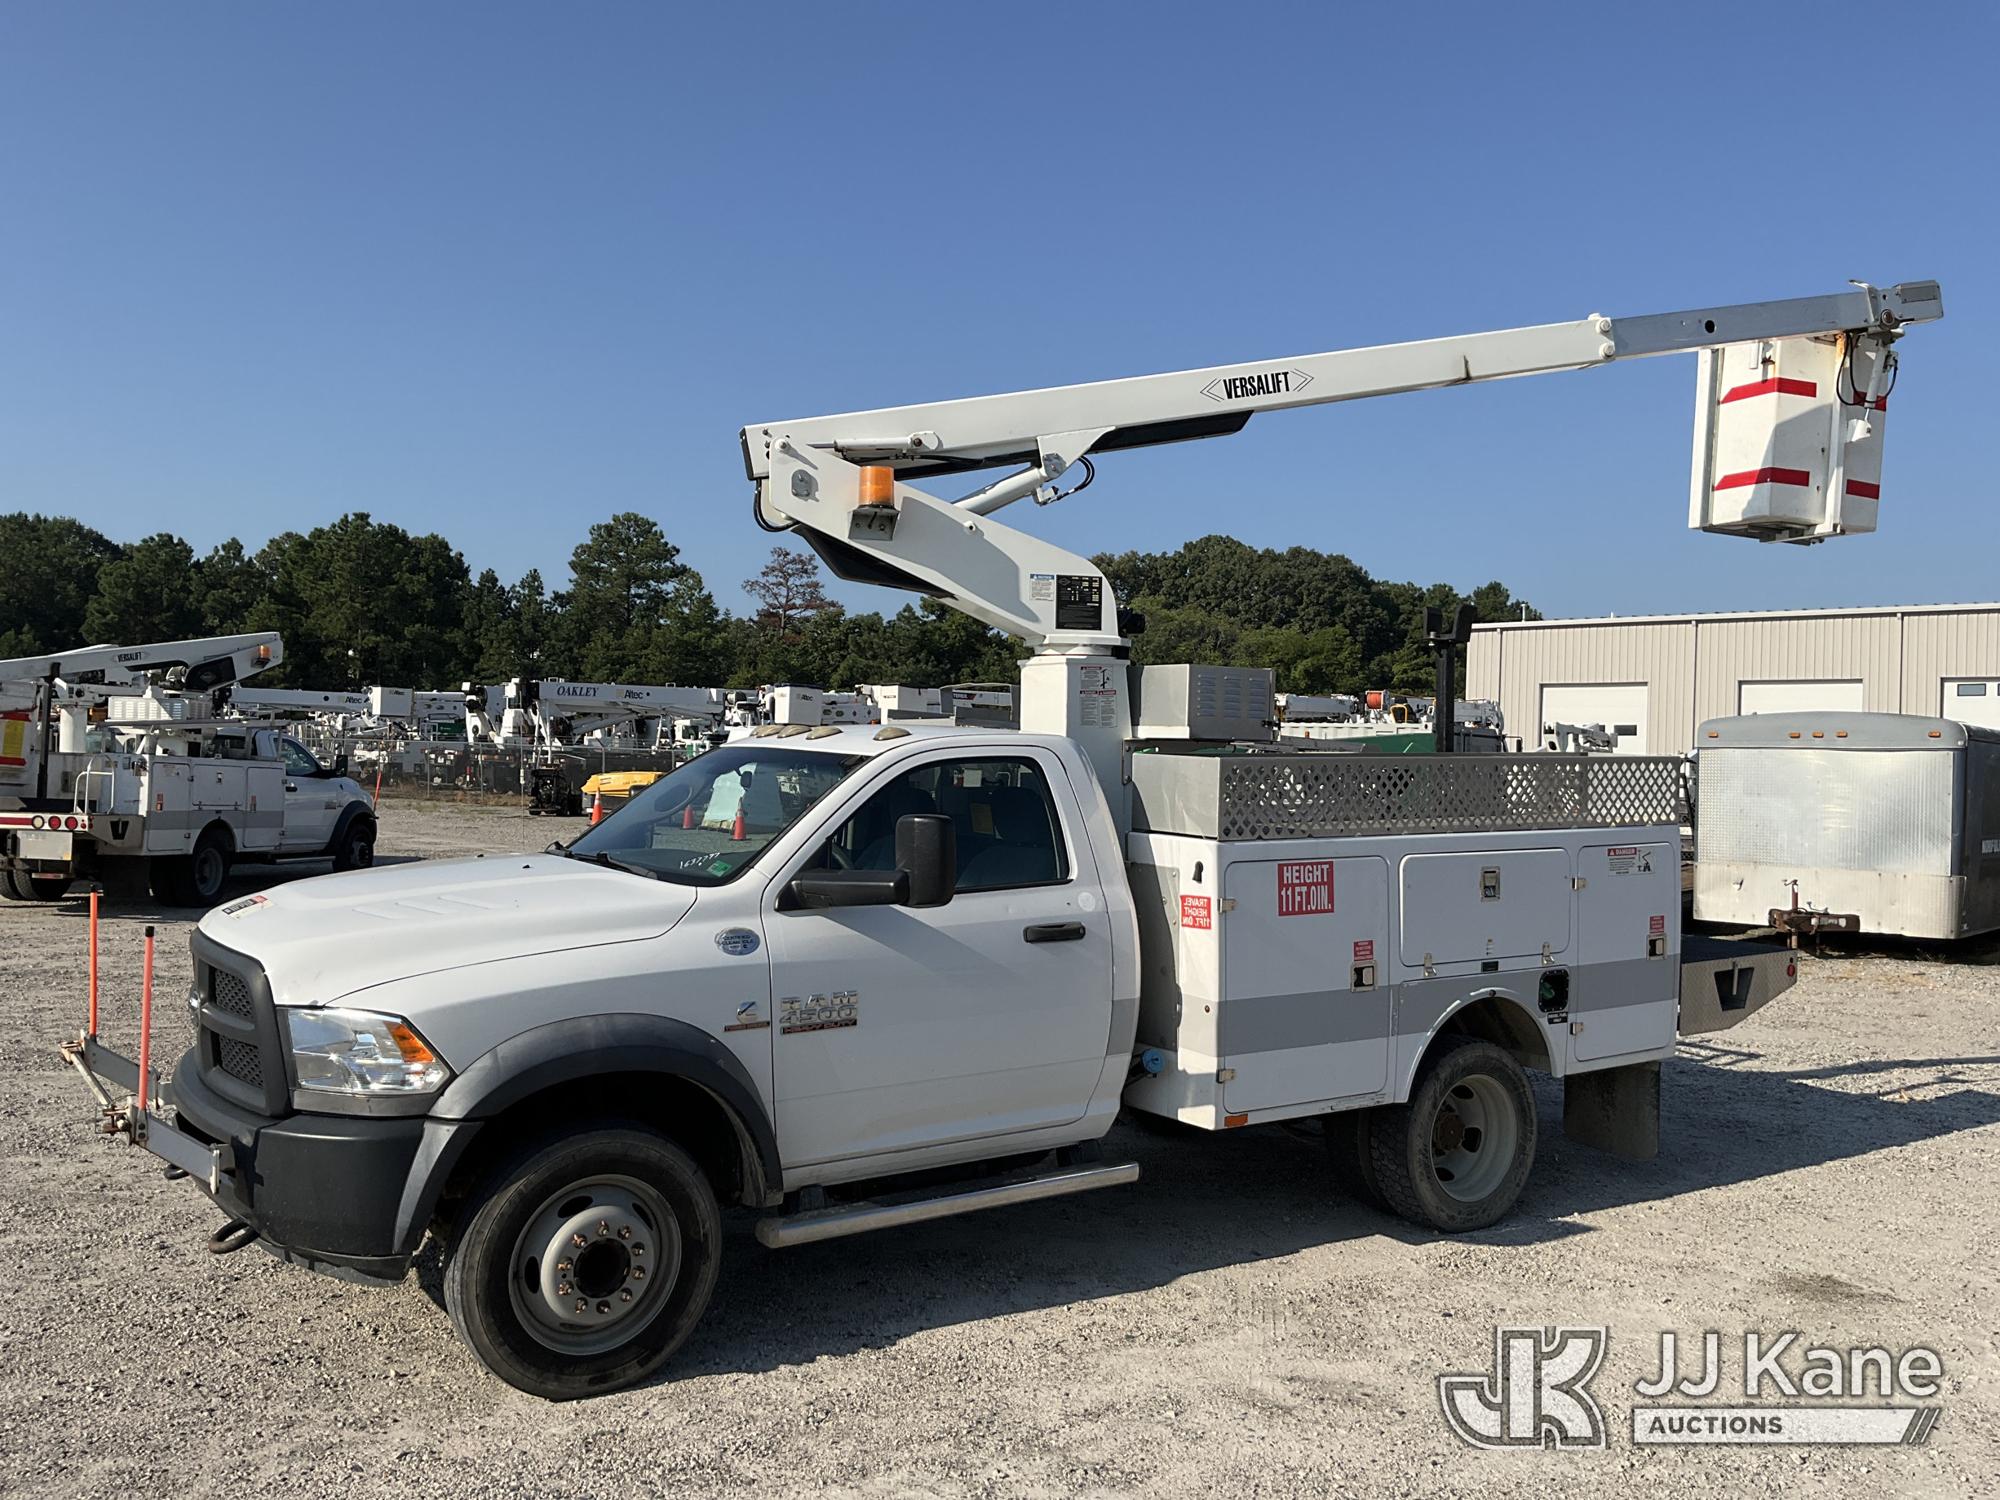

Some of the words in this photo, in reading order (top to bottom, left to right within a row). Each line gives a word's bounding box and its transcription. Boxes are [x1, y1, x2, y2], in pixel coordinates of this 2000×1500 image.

[1223, 371, 1290, 399] VERSALIFT
[117, 651, 142, 662] VERSALIFT
[557, 686, 599, 697] OAKLEY
[624, 689, 644, 699] Altec
[1616, 848, 1635, 856] DANGER
[1283, 864, 1330, 885] HEIGHT
[781, 991, 857, 1011] RAM
[779, 1005, 858, 1024] 4500
